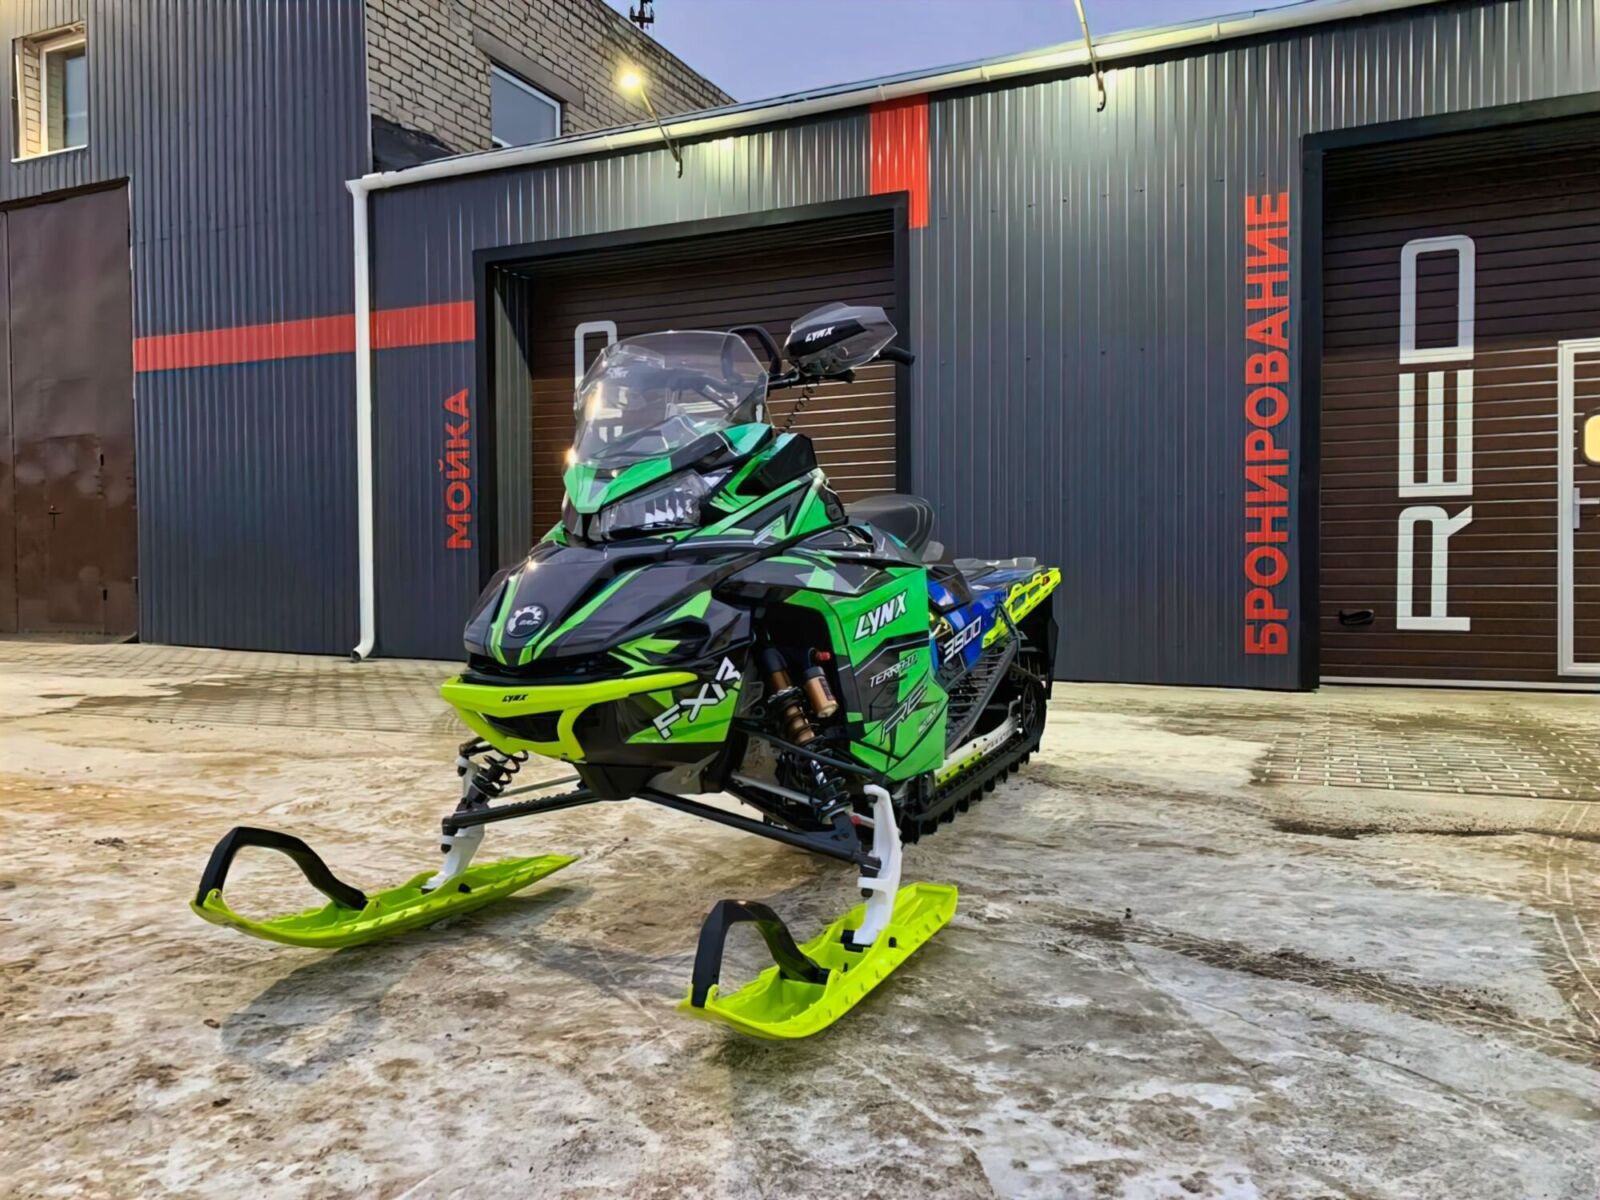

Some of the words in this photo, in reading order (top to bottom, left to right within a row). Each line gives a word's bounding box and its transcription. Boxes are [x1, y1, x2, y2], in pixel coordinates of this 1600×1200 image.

[805, 325, 836, 342] LYNX
[438, 387, 472, 549] МОЙКА
[1245, 192, 1289, 655] БРОНИРОВАНИЕ
[1396, 235, 1476, 632] RED
[853, 590, 908, 641] LYNX
[652, 655, 742, 739] FXR
